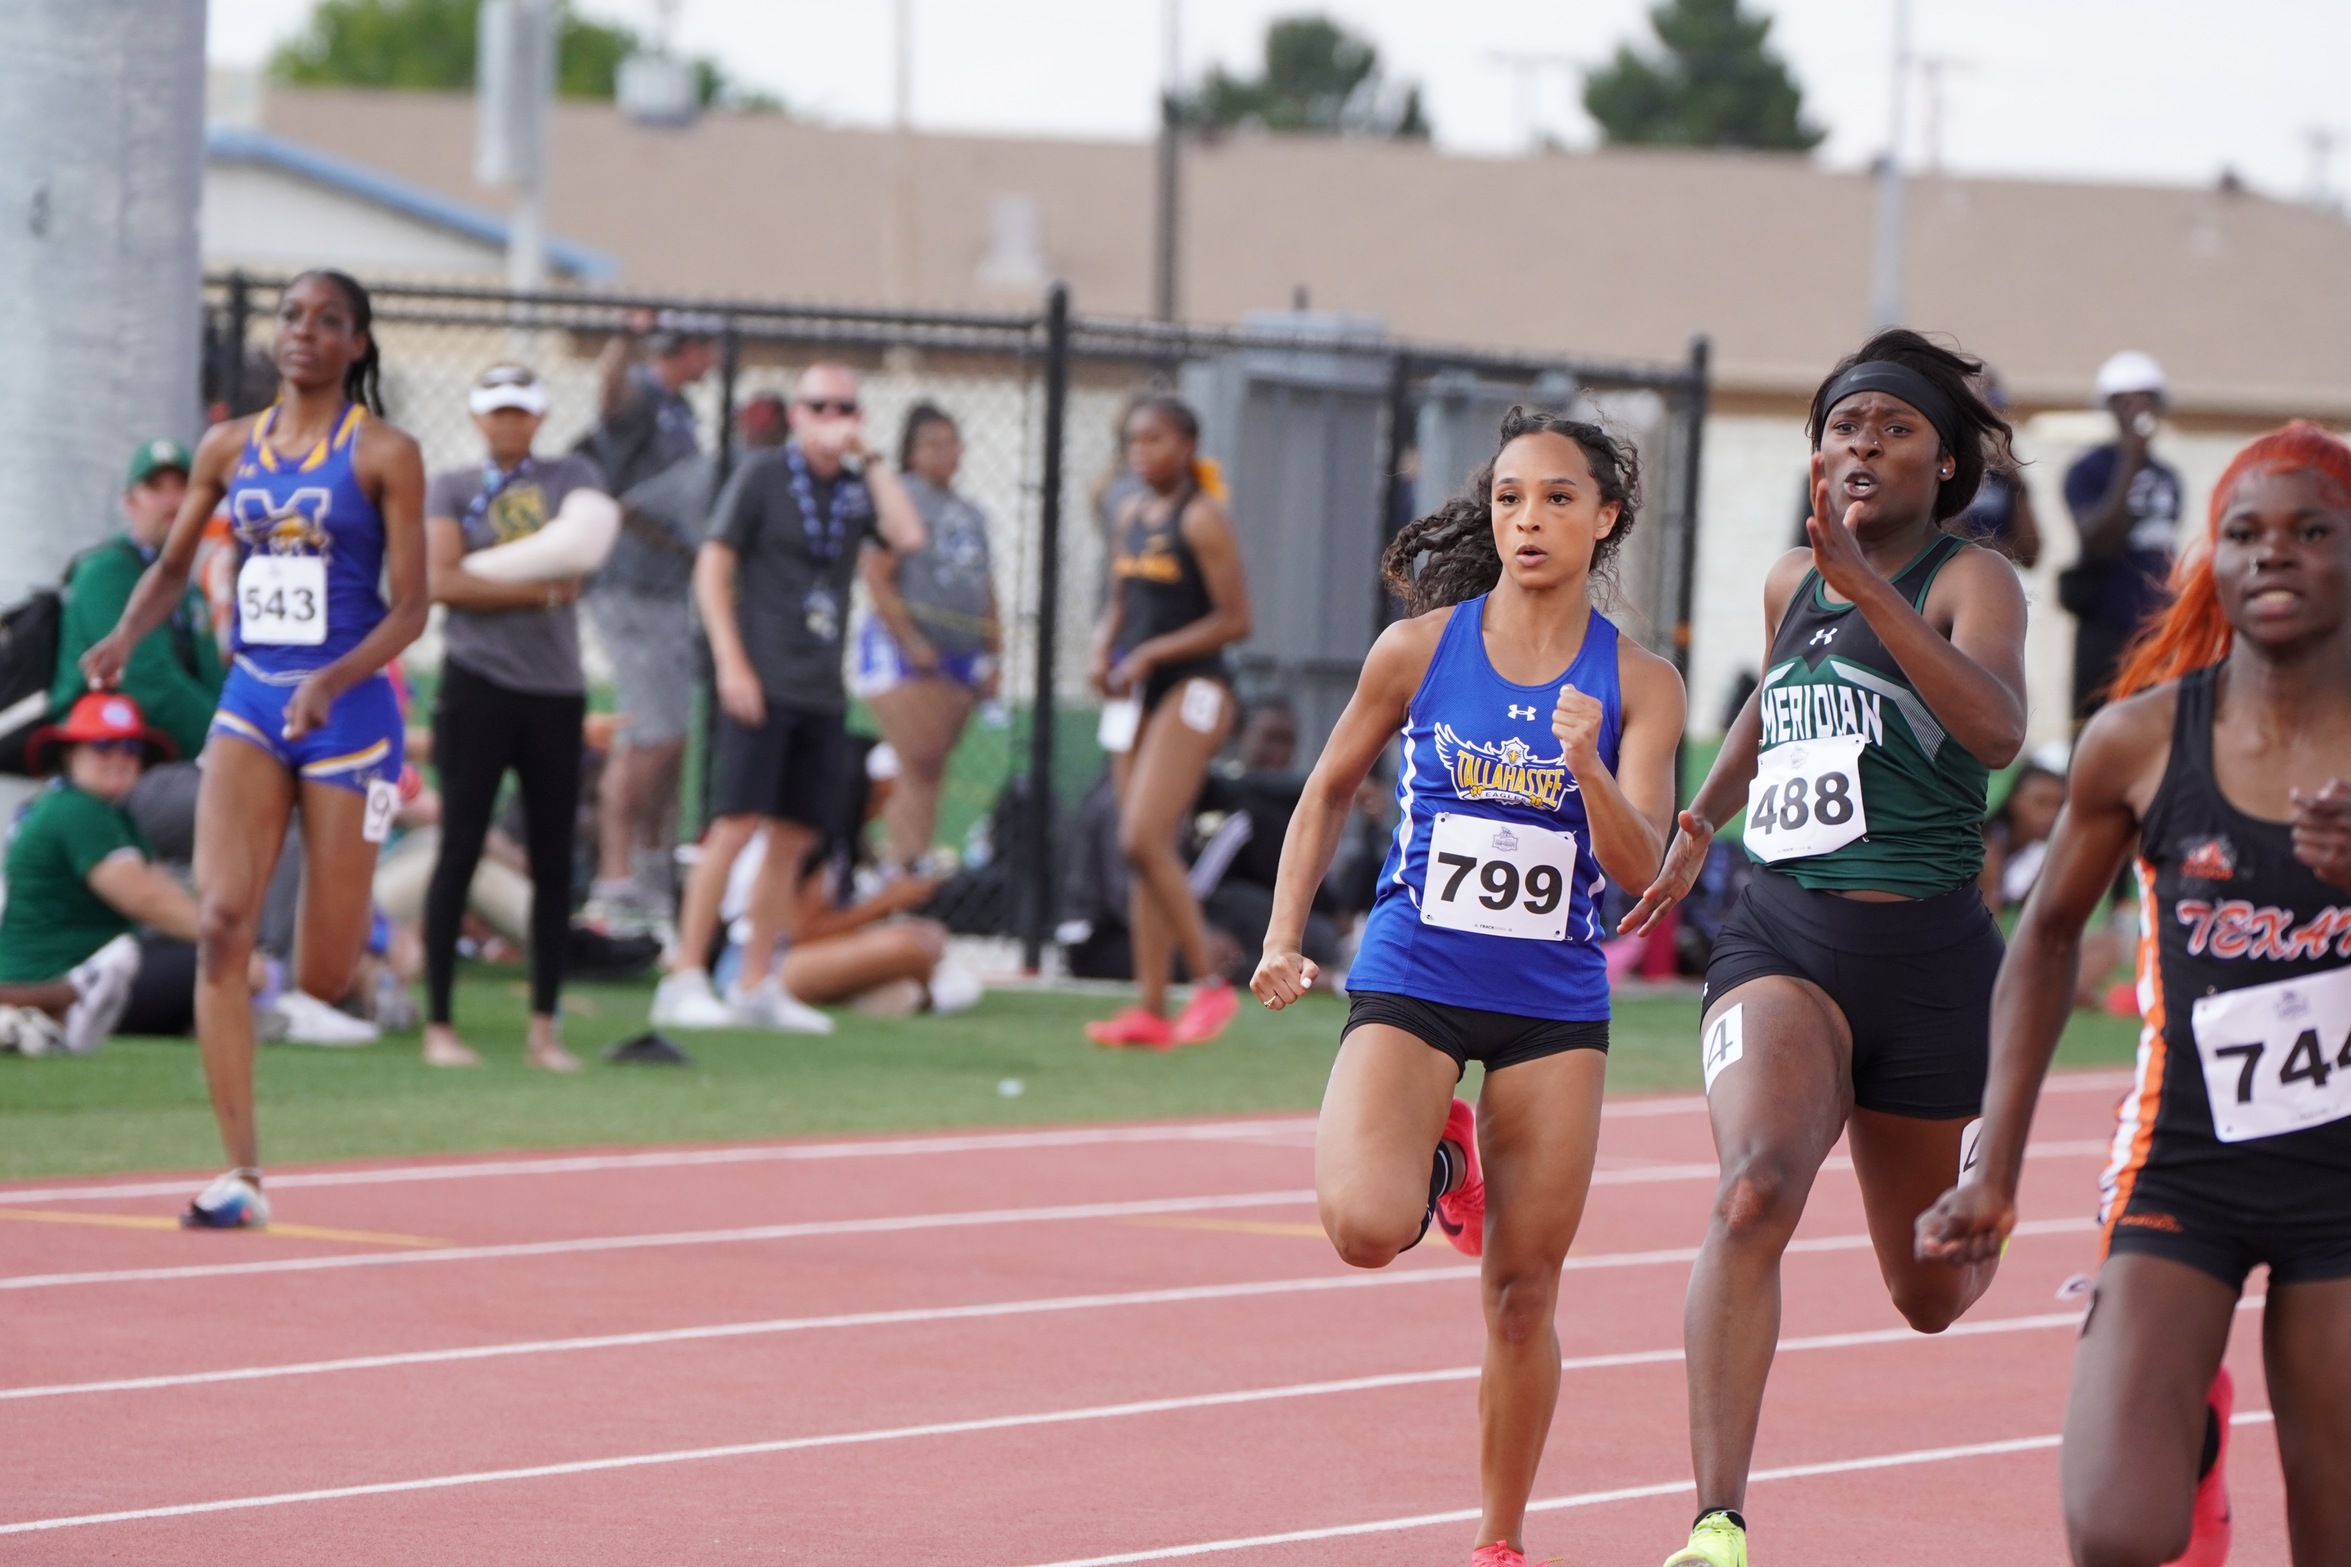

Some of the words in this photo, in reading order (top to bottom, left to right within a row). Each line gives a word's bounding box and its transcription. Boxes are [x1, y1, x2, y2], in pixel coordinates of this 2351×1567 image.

[246, 586, 316, 622] 543
[1761, 684, 1883, 747] MERIDIAN
[1457, 749, 1565, 808] TALLAHASSEE
[1750, 771, 1854, 836] 488
[1437, 851, 1563, 915] 799
[1707, 1018, 1733, 1072] 4
